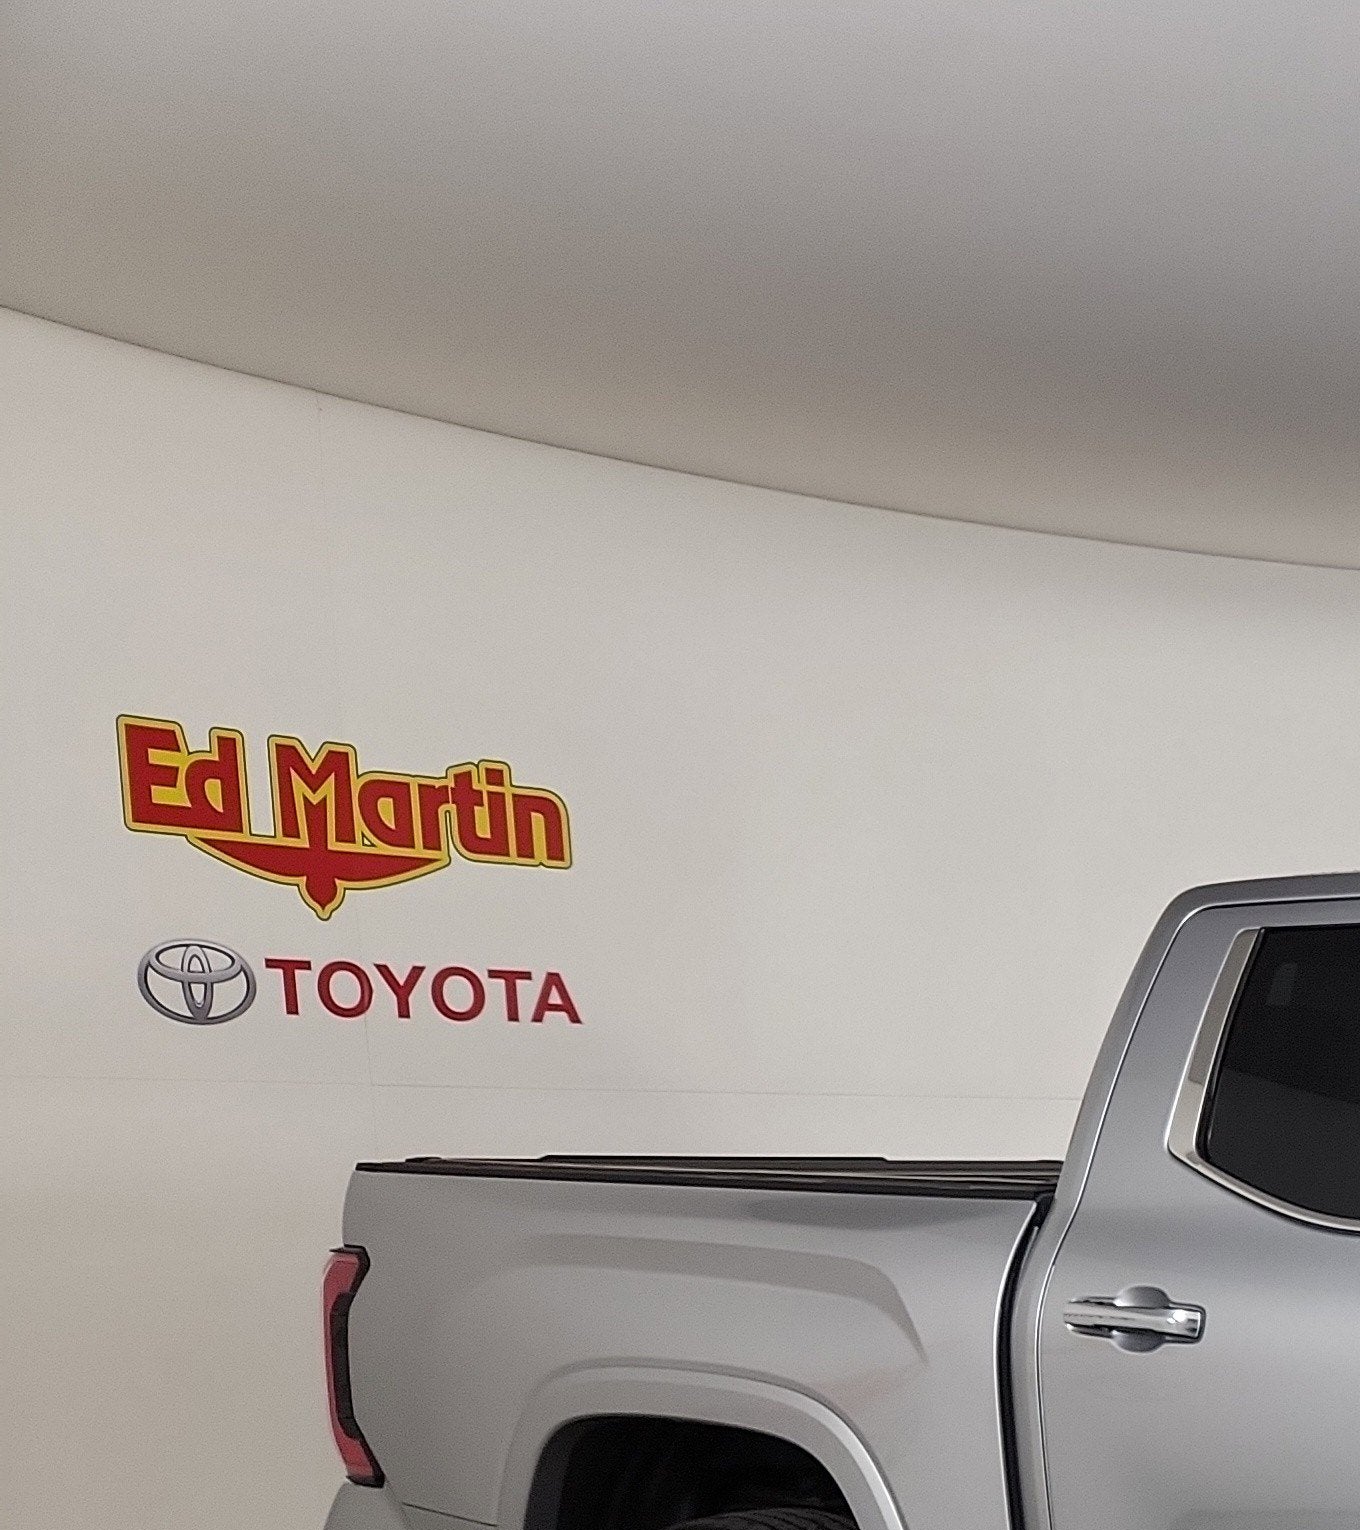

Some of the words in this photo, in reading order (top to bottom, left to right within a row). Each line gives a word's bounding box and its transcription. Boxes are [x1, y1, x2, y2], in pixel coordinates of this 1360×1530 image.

[119, 718, 246, 835] Ed
[273, 738, 568, 864] Martin
[264, 957, 584, 1025] TOYOTA
